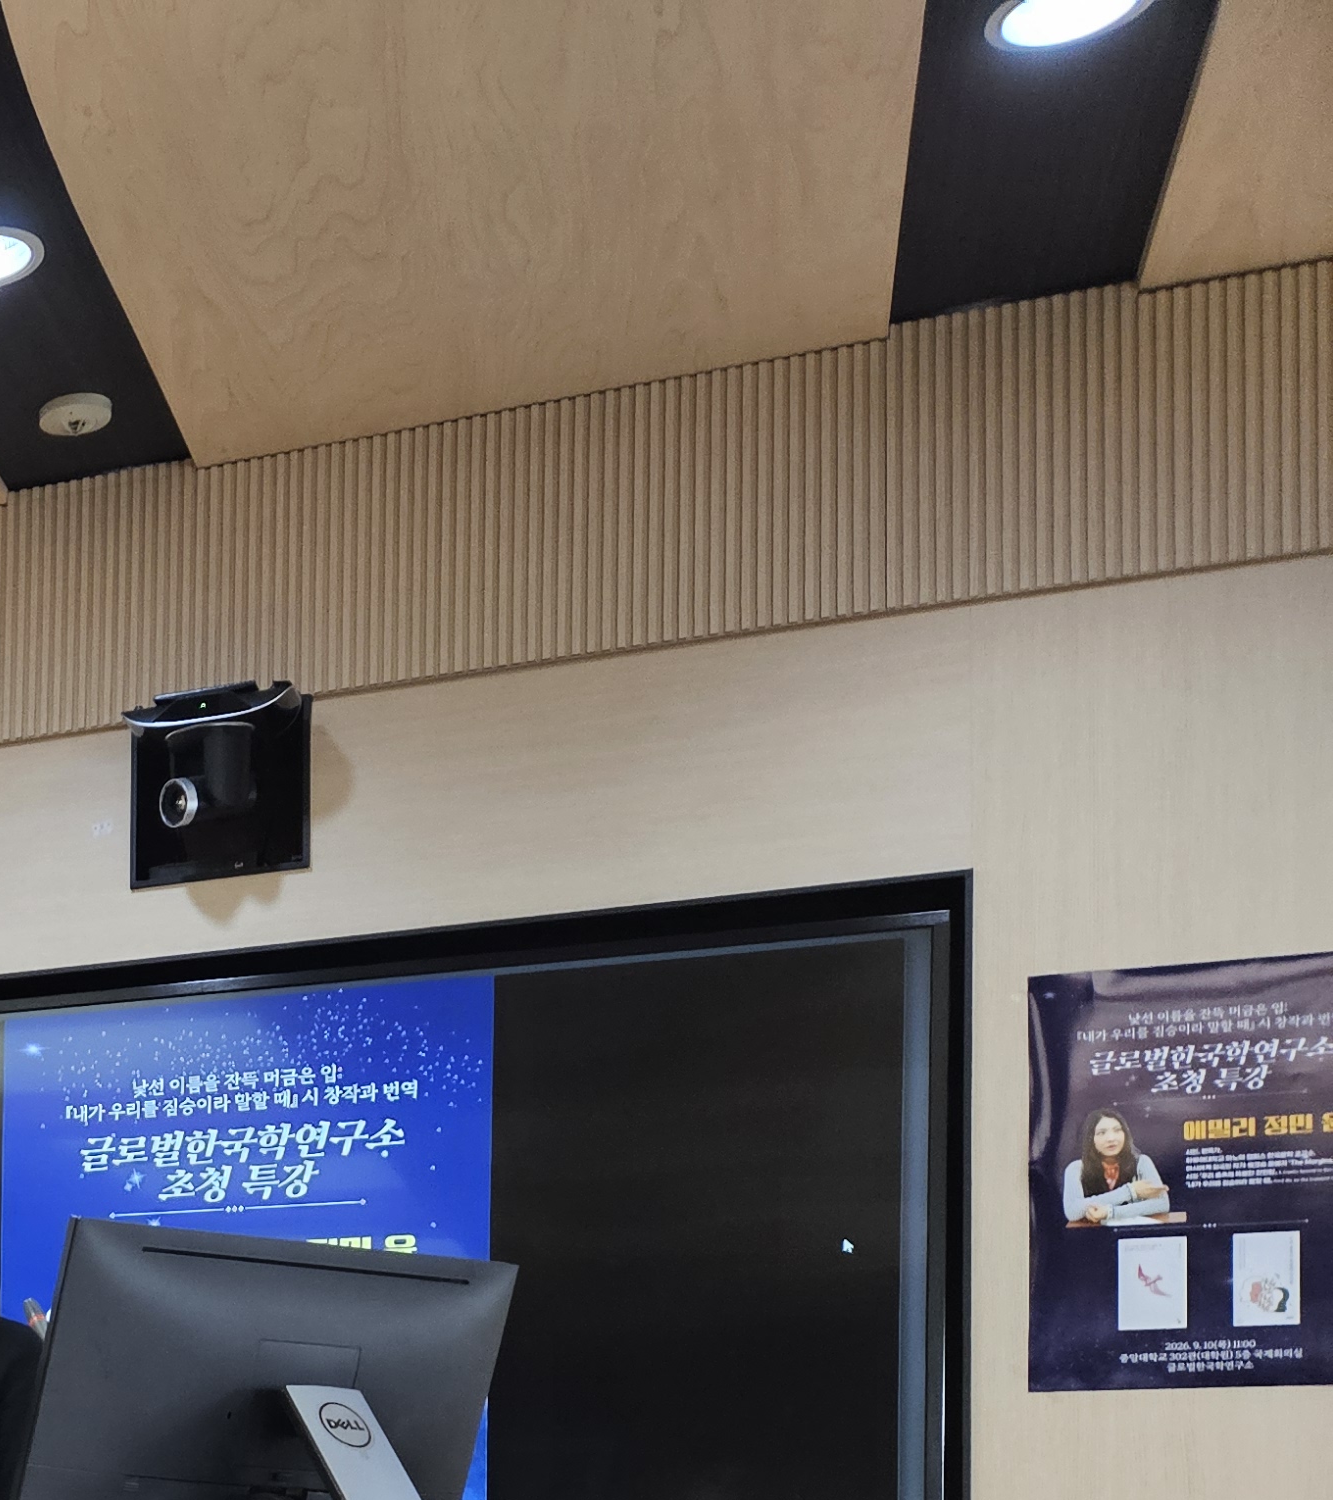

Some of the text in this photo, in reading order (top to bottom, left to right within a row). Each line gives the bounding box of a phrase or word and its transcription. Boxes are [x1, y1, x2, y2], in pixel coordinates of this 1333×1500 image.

[1111, 1025, 1149, 1041] 우리를
[1258, 1016, 1271, 1030] 시
[1318, 1012, 1333, 1026] 번
[1089, 1036, 1333, 1076] 글로벌한국학연구소
[132, 1078, 164, 1098] 낯선
[169, 1075, 220, 1095] 이름을
[224, 1071, 259, 1090] 잔뜩
[263, 1066, 316, 1088] 머금은
[1150, 1063, 1272, 1094] 초청 특강
[108, 1100, 159, 1121] 우리를
[162, 1094, 231, 1117] 짐승이라
[234, 1091, 270, 1112] 말할
[301, 1087, 319, 1107] 시
[323, 1082, 379, 1105] 창작과
[383, 1078, 418, 1101] 번역
[1183, 1116, 1256, 1141] 에밀리
[1263, 1113, 1313, 1136] 정민
[80, 1118, 405, 1172] 글로벌한국학연구소
[158, 1160, 320, 1203] 초청 특강
[1233, 1339, 1257, 1349] 11:00
[325, 1418, 365, 1431] DELL
